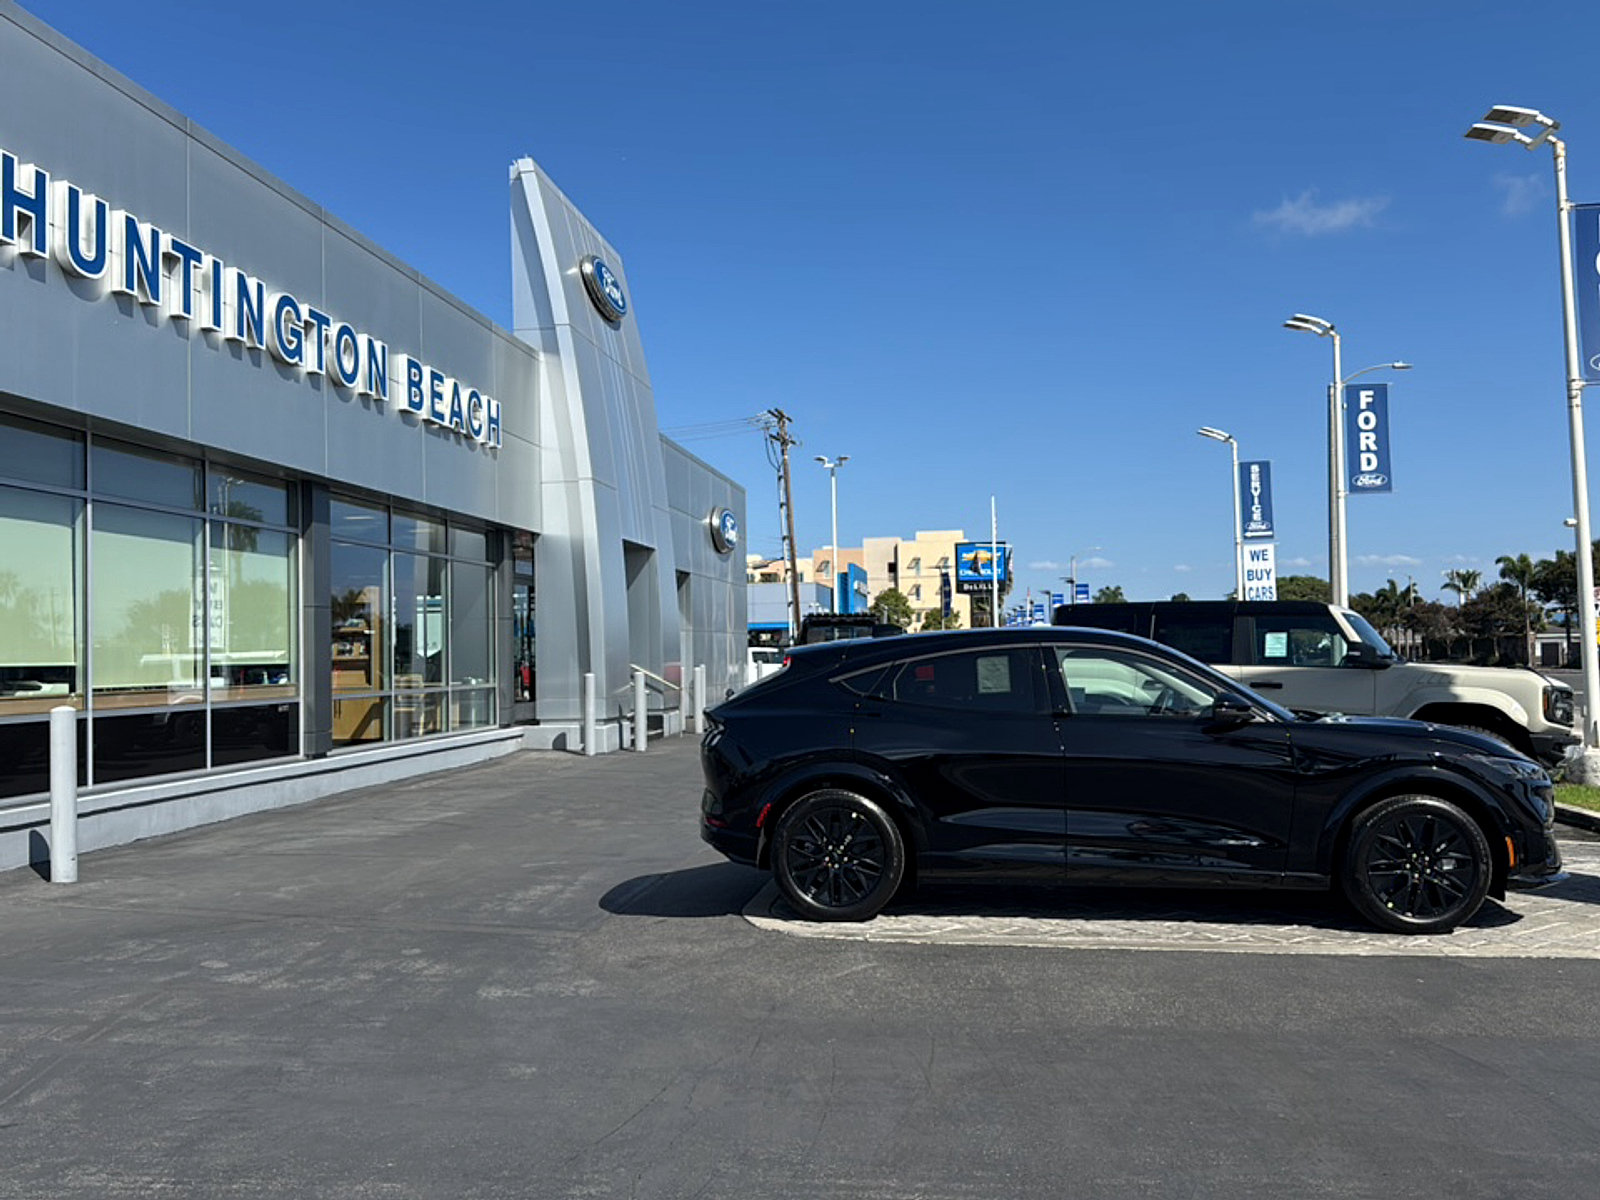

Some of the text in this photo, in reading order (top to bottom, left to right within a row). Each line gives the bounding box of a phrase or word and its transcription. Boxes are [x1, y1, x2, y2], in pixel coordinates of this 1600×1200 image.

[0, 148, 502, 449] HUNTINGTON BEACH
[1357, 389, 1378, 472] FORD
[1250, 464, 1262, 521] SERVICE
[1250, 549, 1269, 562] WE
[1247, 569, 1272, 581] BUY
[1247, 586, 1275, 600] CARS
